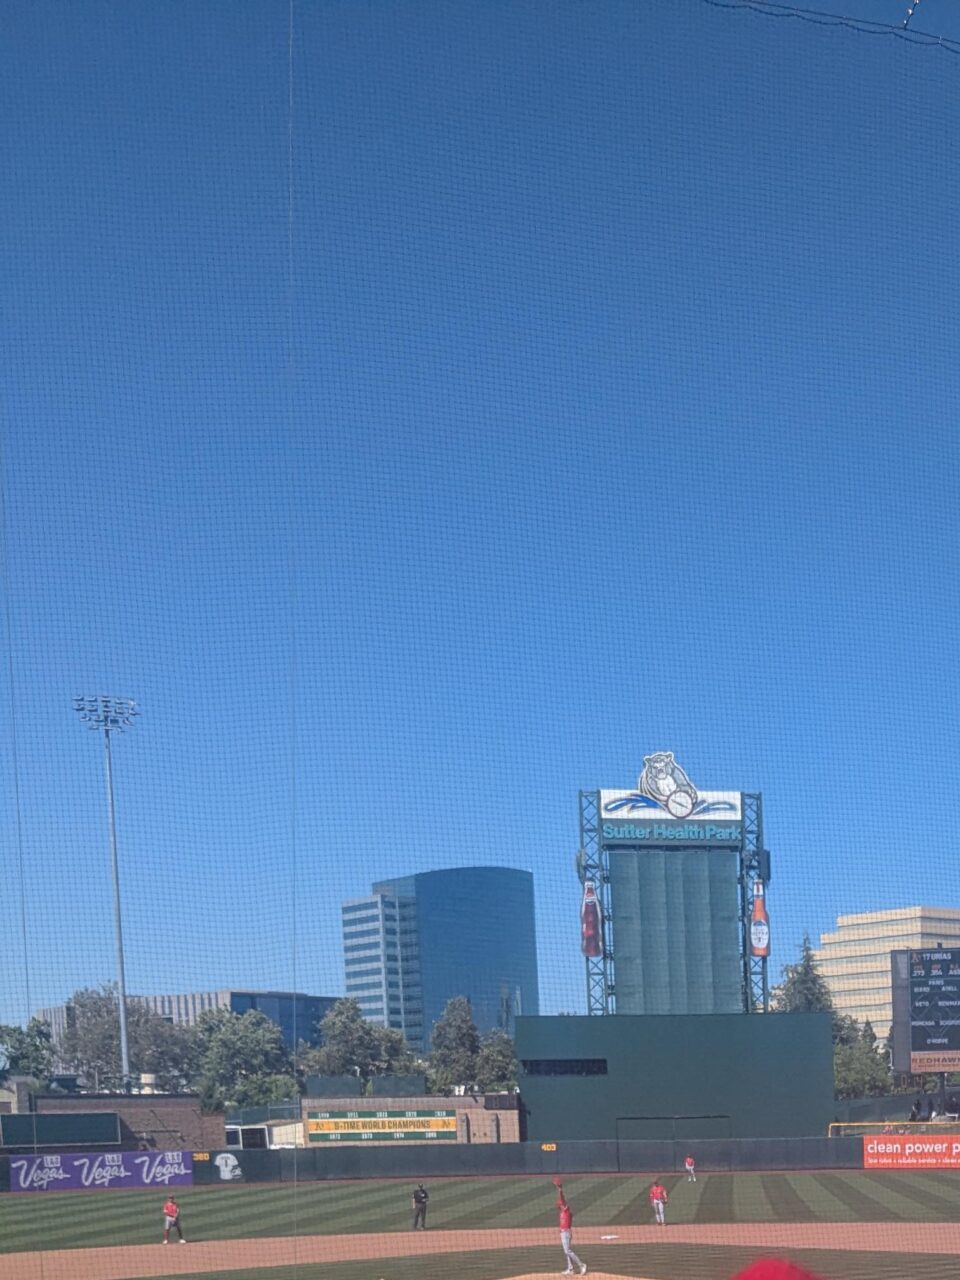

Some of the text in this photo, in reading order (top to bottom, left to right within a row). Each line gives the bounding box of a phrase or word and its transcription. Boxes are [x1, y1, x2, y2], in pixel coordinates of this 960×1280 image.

[603, 824, 742, 840] Sutter Health Park
[361, 1120, 387, 1130] WORLD
[387, 1119, 431, 1130] CHAMPIONS
[867, 1140, 901, 1153] clean
[905, 1142, 947, 1156] power
[11, 1158, 71, 1189] Vegas
[74, 1156, 132, 1187] Vegas
[135, 1155, 192, 1184] Vegas
